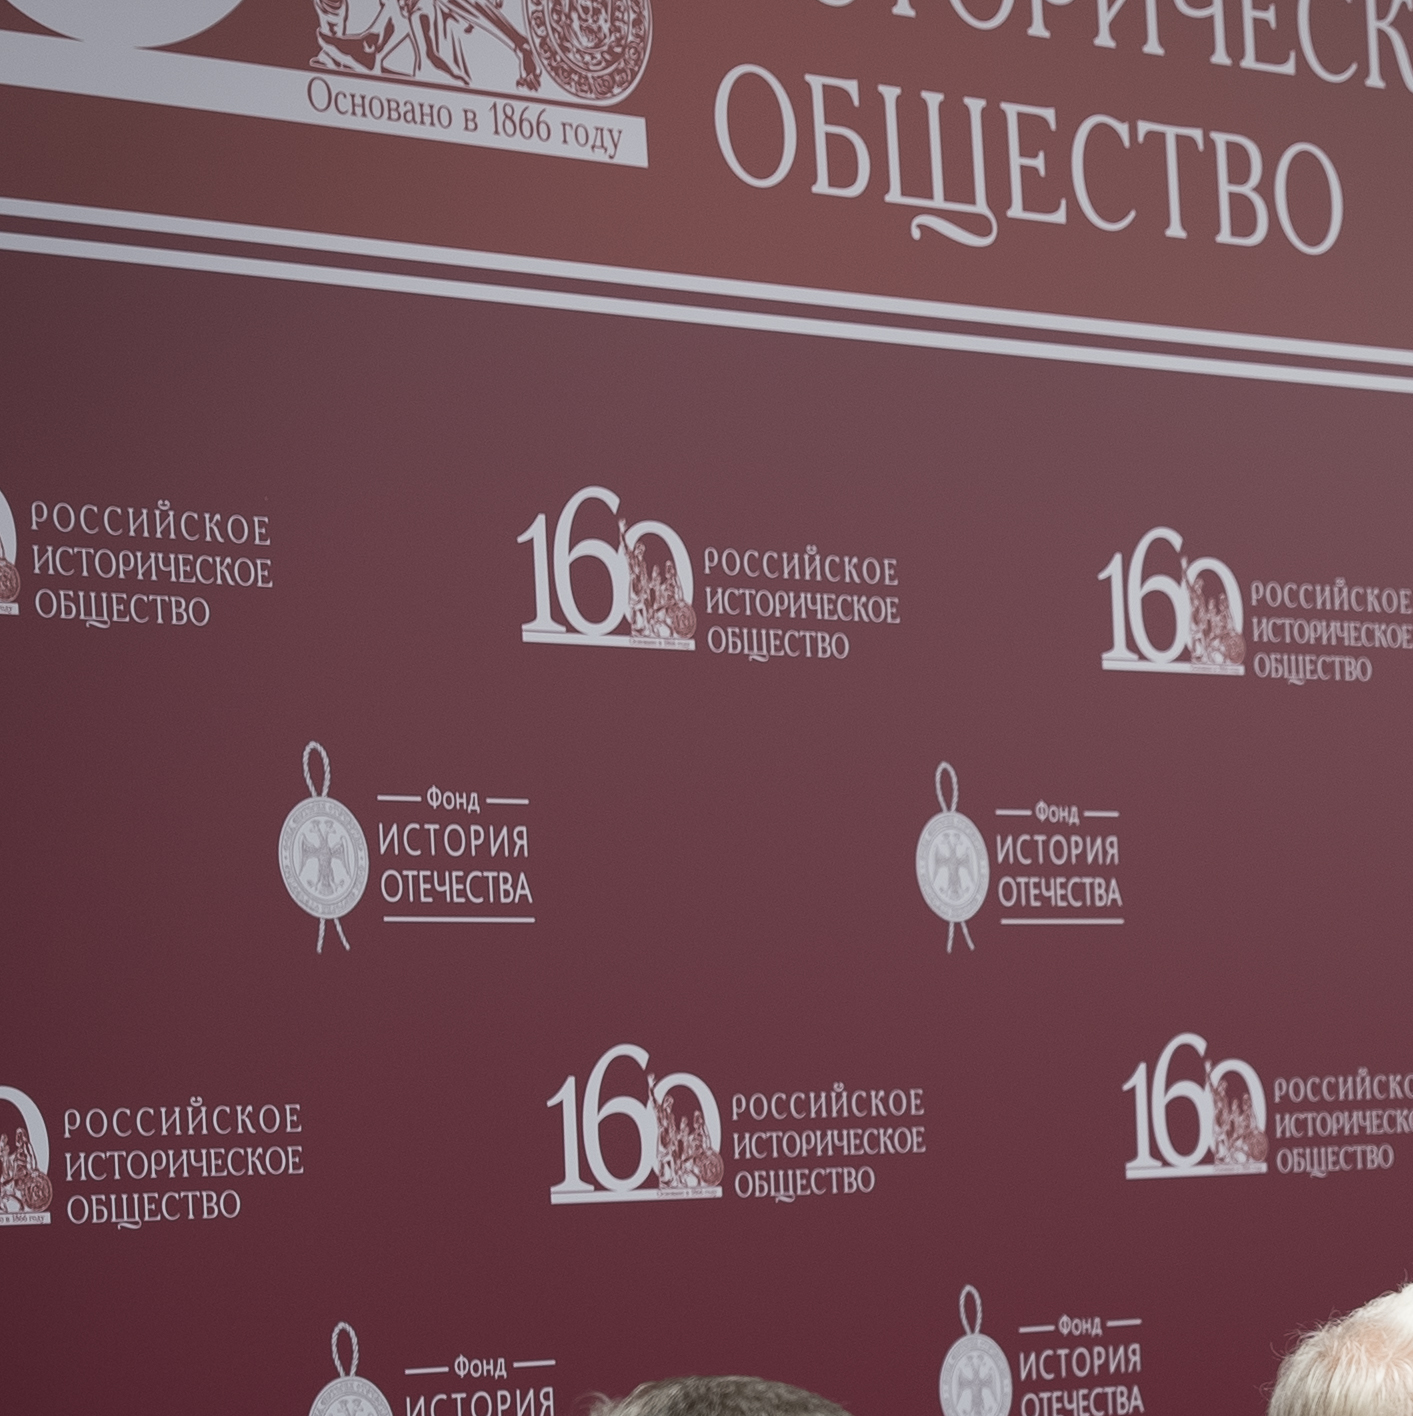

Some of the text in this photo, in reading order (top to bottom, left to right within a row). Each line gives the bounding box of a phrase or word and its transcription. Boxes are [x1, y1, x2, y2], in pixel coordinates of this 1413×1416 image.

[307, 76, 622, 160] Основано в 1866 году
[713, 63, 1345, 255] ОБЩЕСТВО
[30, 499, 271, 546] РОССИЙСКОЕ
[32, 544, 273, 588] ИСТОРИЧЕСКОЕ
[704, 544, 899, 586] РОССИЙСКОЕ
[34, 588, 211, 629] ОБЩЕСТВО
[705, 586, 900, 624] ИСТОРИЧЕСКОЕ
[1251, 577, 1413, 614] РОССИЙСКОЕ
[707, 625, 850, 662] ОБЩЕСТВО
[1254, 652, 1372, 686] ОБЩЕСТВО
[426, 784, 481, 814] Фонд
[1035, 800, 1080, 826] Фонд
[378, 822, 529, 857] ИСТОРИЯ
[996, 834, 1120, 865] ИСТОРИЯ
[380, 869, 533, 904] ОТЕЧЕСТВА
[998, 876, 1123, 907] ОТЕЧЕСТВА
[63, 1096, 302, 1139] РОССИЙСКОЕ
[731, 1081, 925, 1121] РОССИЙСКОЕ
[732, 1126, 927, 1160] ИСТОРИЧЕСКОЕ
[1277, 1143, 1395, 1179] ОБЩЕСТВО
[65, 1145, 304, 1182] ИСТОРИЧЕСКОЕ
[734, 1166, 876, 1203] ОБЩЕСТВО
[66, 1189, 241, 1230] ОБЩЕСТВО
[1058, 1314, 1103, 1337] Фонд
[454, 1353, 507, 1380] Фонд
[1019, 1343, 1142, 1382] ИСТОРИЯ
